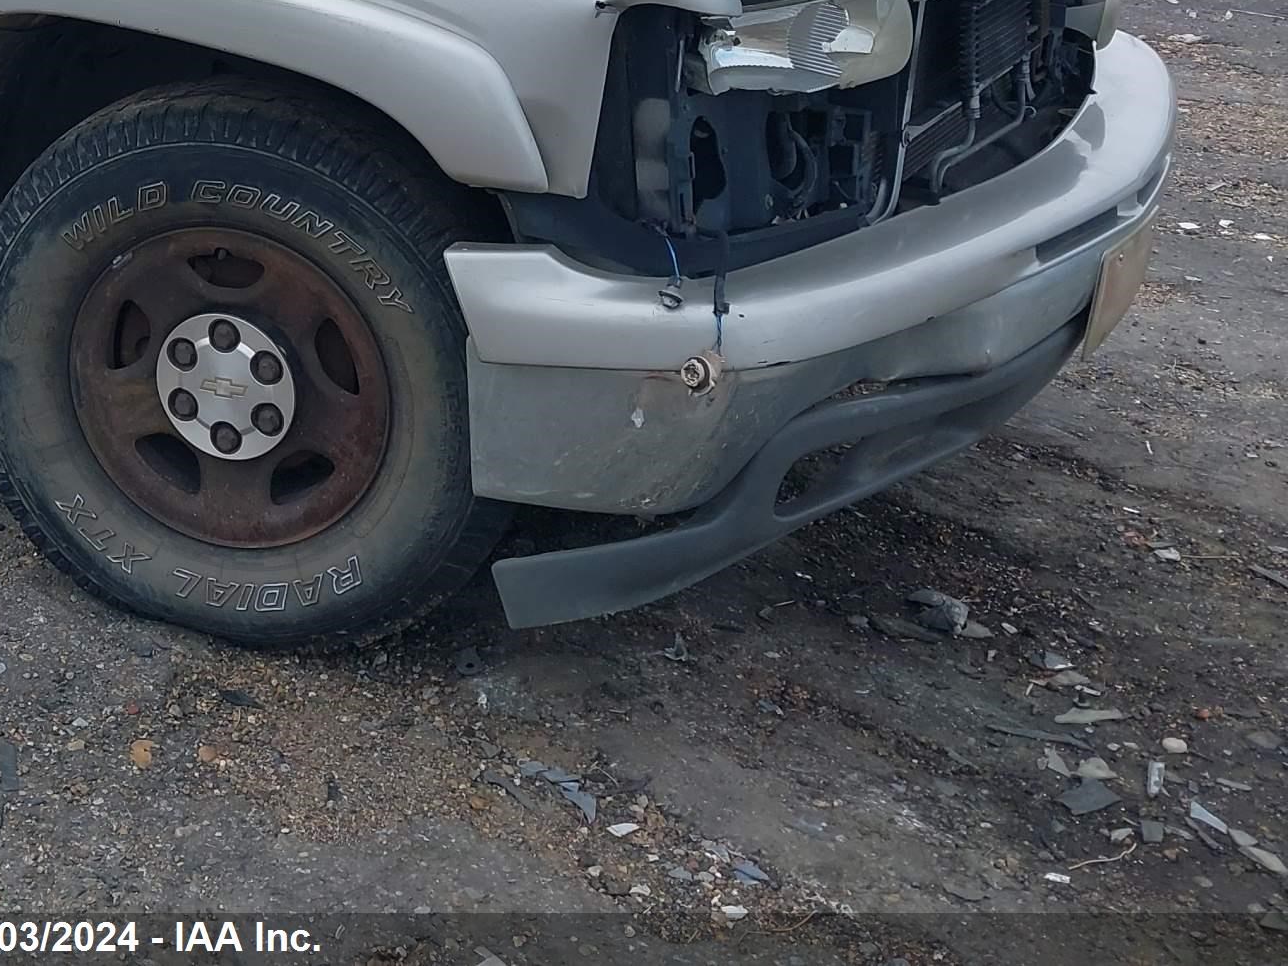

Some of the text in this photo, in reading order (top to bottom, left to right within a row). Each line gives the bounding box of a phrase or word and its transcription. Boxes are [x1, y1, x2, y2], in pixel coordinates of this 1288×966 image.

[62, 179, 415, 315] WILD COUNTRY
[53, 492, 363, 613] RADIAL XTX
